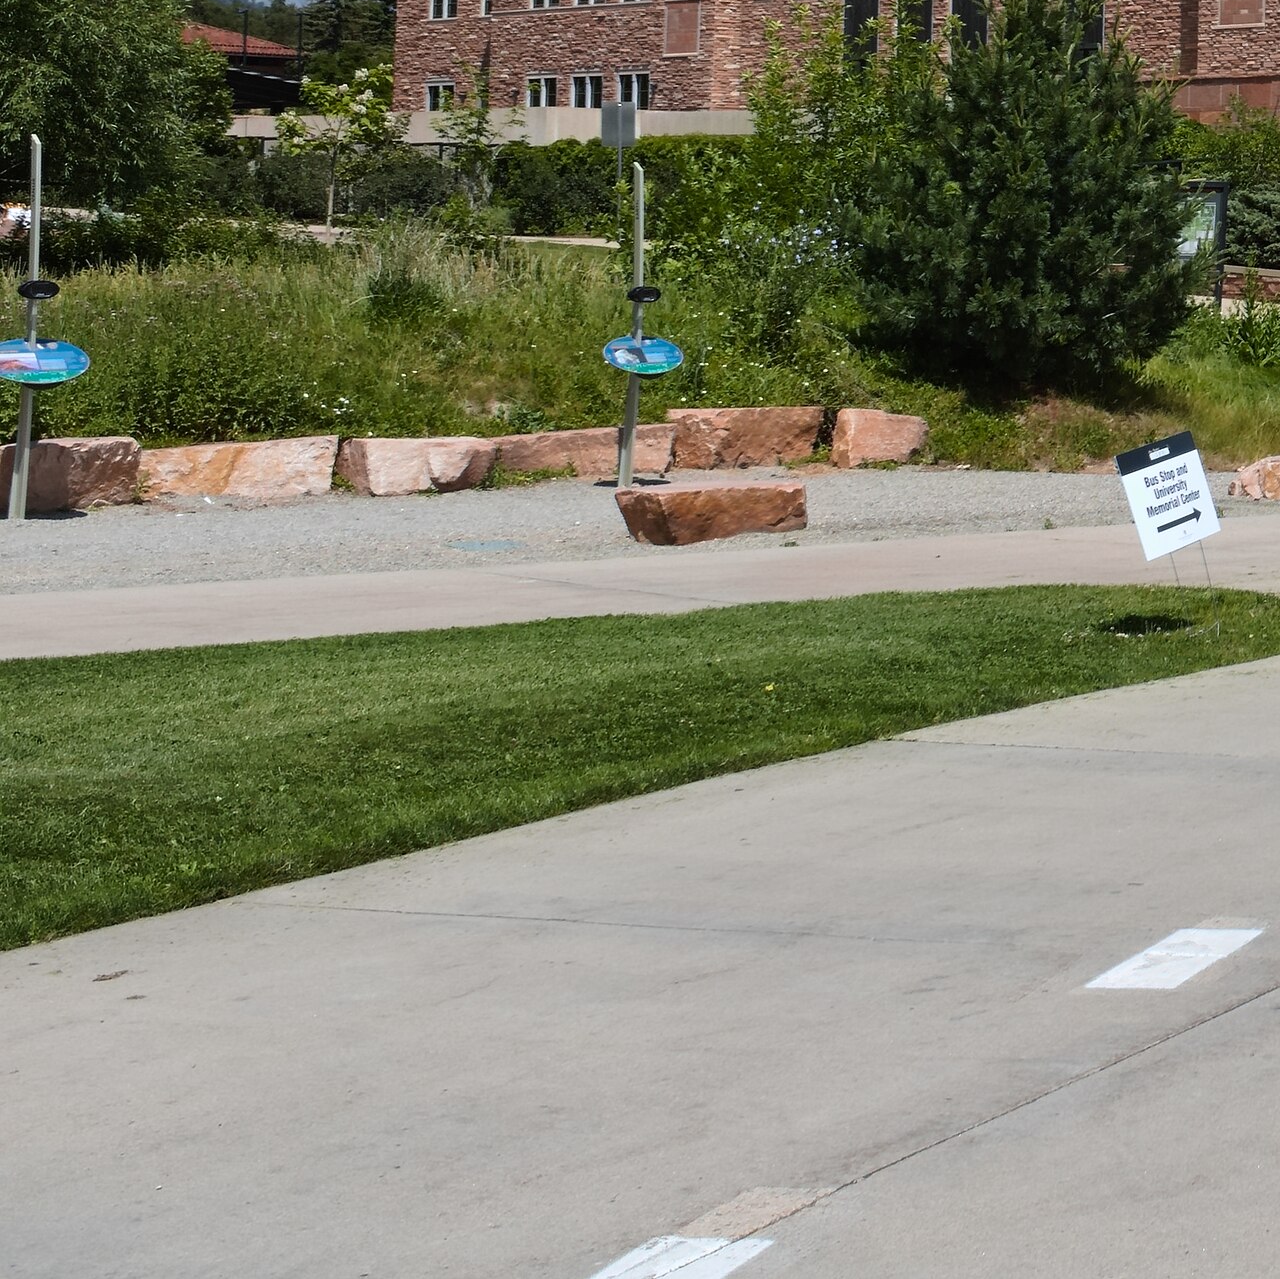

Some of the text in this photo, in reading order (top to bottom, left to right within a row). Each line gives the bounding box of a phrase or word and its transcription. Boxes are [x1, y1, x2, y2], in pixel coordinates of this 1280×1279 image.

[1144, 463, 1188, 488] Bus Stop and
[1154, 479, 1188, 499] University
[1147, 490, 1200, 518] Memorial Center
